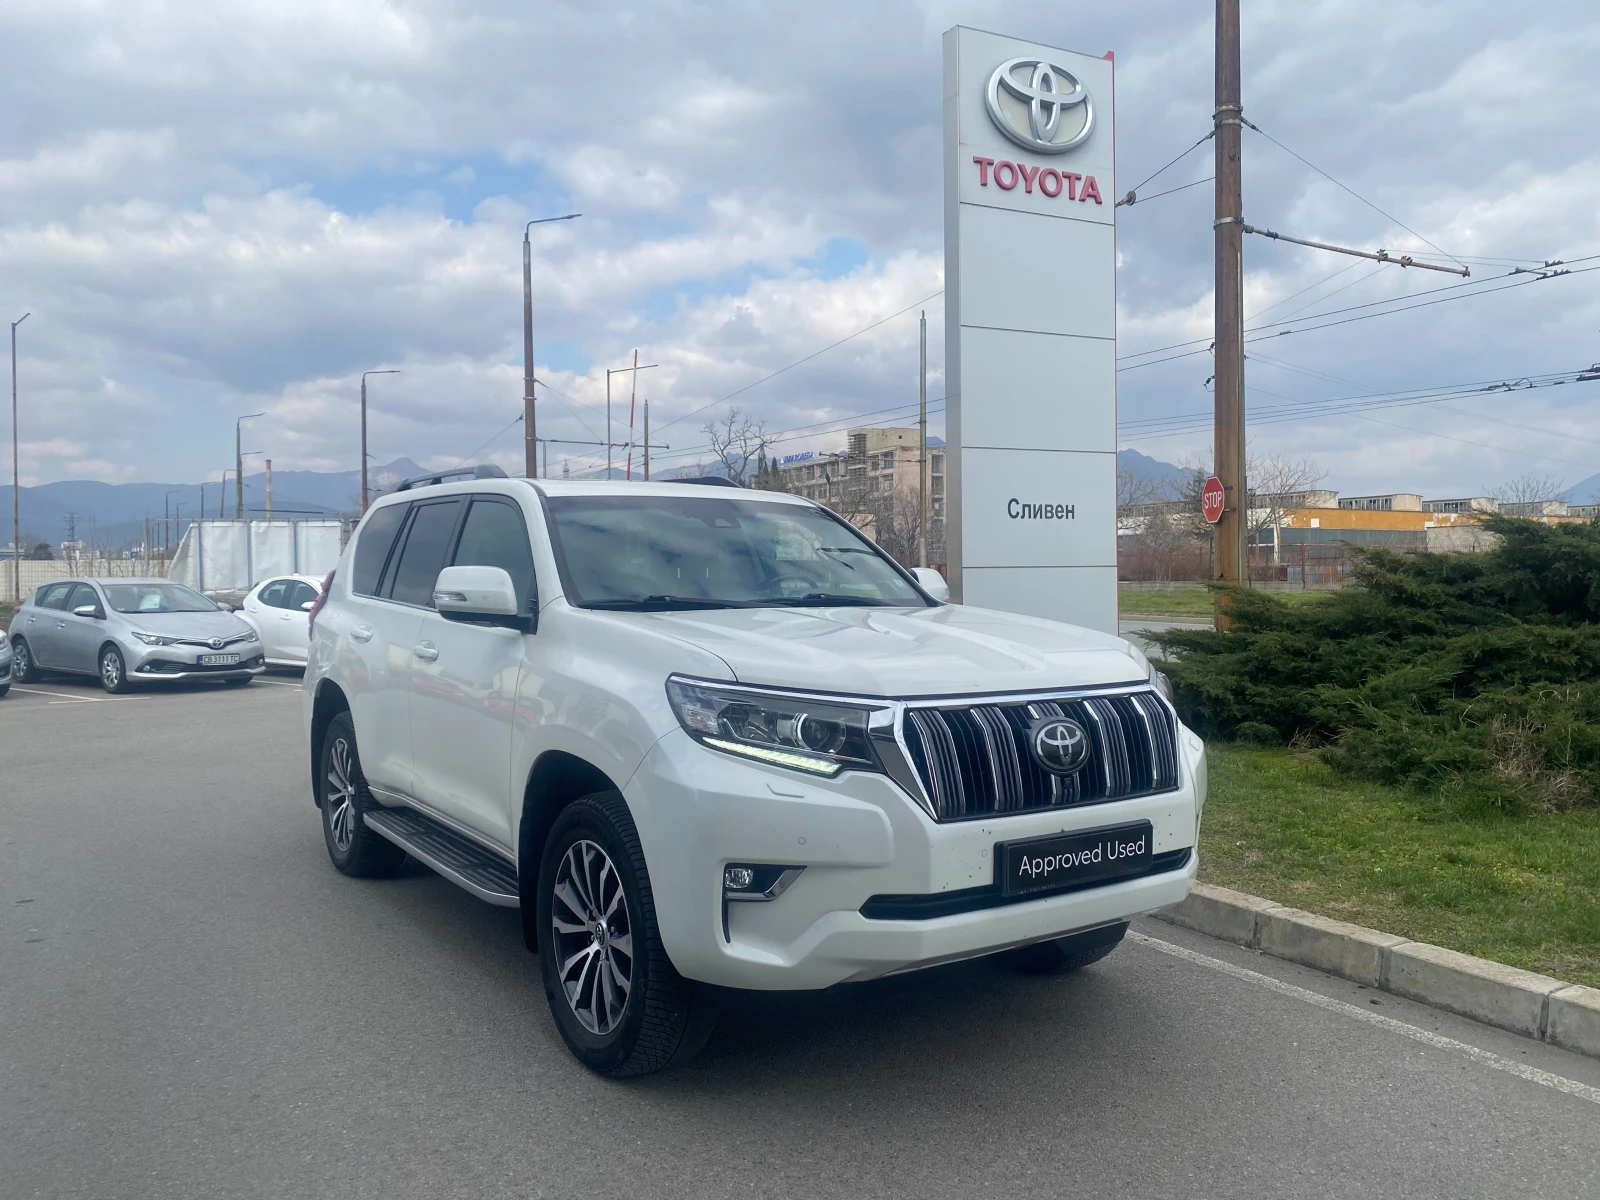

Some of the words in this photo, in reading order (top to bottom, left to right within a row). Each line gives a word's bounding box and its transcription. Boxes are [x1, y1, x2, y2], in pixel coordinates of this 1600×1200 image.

[973, 156, 1103, 204] TOYOTA
[1007, 498, 1075, 519] Сливен
[1204, 491, 1223, 509] STOP
[1019, 842, 1102, 879] Approved
[1107, 834, 1145, 860] Used
